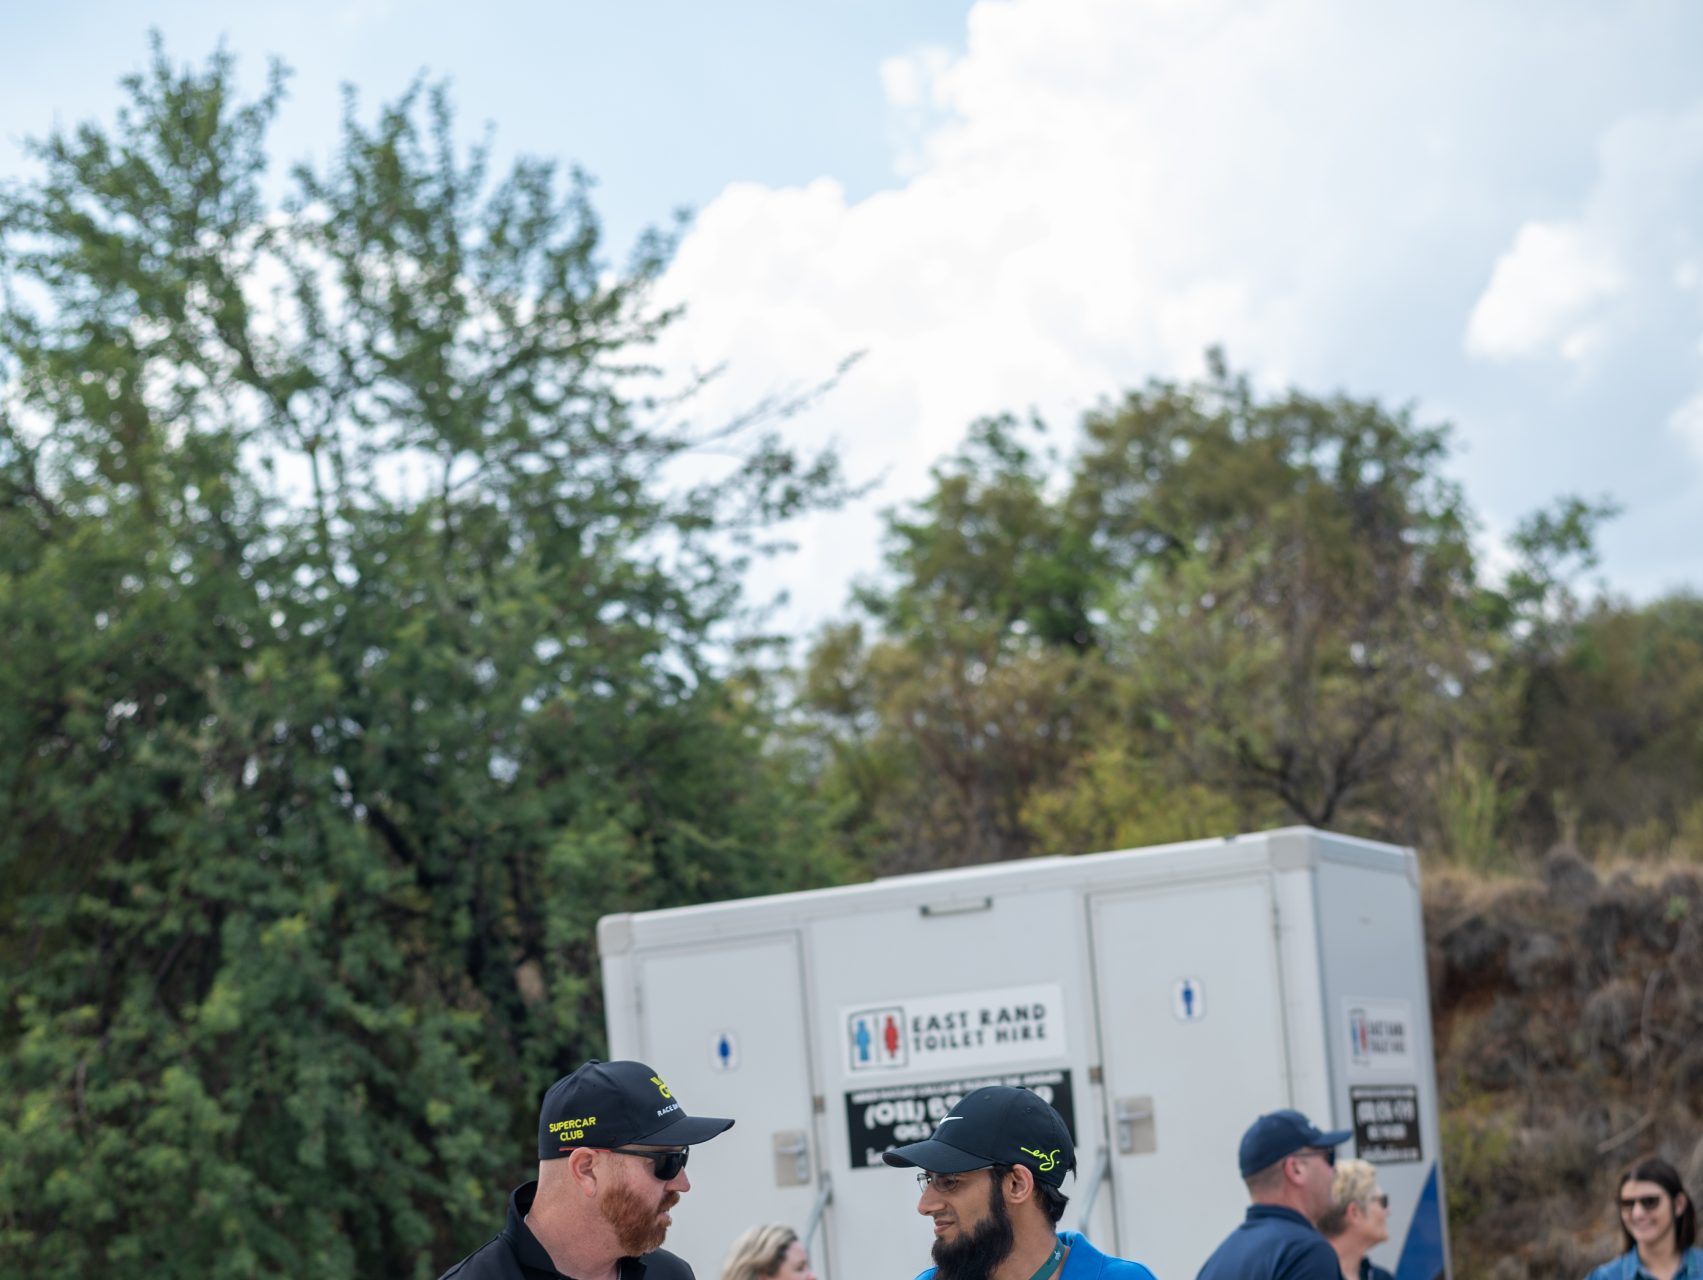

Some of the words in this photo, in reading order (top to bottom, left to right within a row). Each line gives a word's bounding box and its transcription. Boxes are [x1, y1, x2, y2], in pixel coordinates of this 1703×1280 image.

[912, 1010, 968, 1033] EAST
[980, 1003, 1046, 1026] RAND
[913, 1029, 984, 1053] TOILET
[995, 1024, 1047, 1044] HIRE
[656, 1103, 673, 1117] RACE
[548, 1116, 597, 1133] SUPERCAR
[559, 1129, 585, 1142] CLUB
